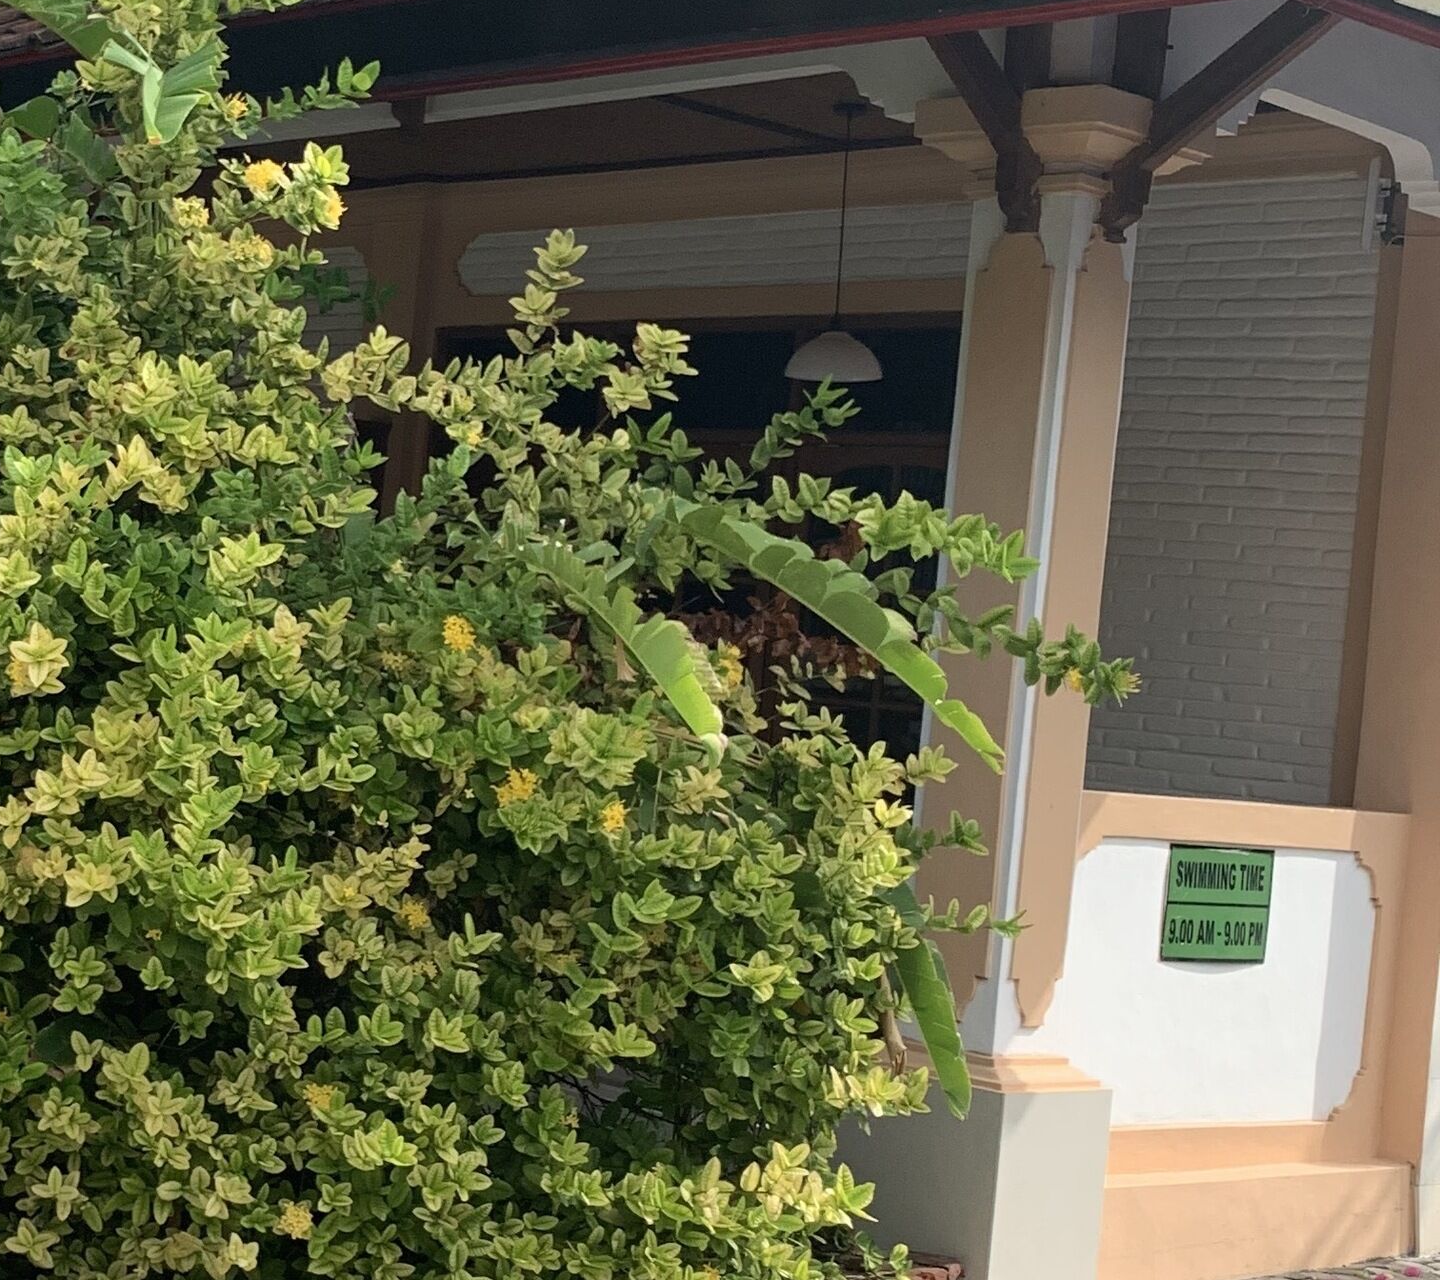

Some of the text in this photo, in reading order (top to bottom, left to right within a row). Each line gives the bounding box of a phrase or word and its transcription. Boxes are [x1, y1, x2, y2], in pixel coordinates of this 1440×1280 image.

[1176, 860, 1265, 891] SWIMMING TIME
[1168, 919, 1194, 944] 9.00
[1196, 920, 1215, 945] AM
[1224, 921, 1246, 946] 9.00
[1248, 922, 1263, 946] PM
